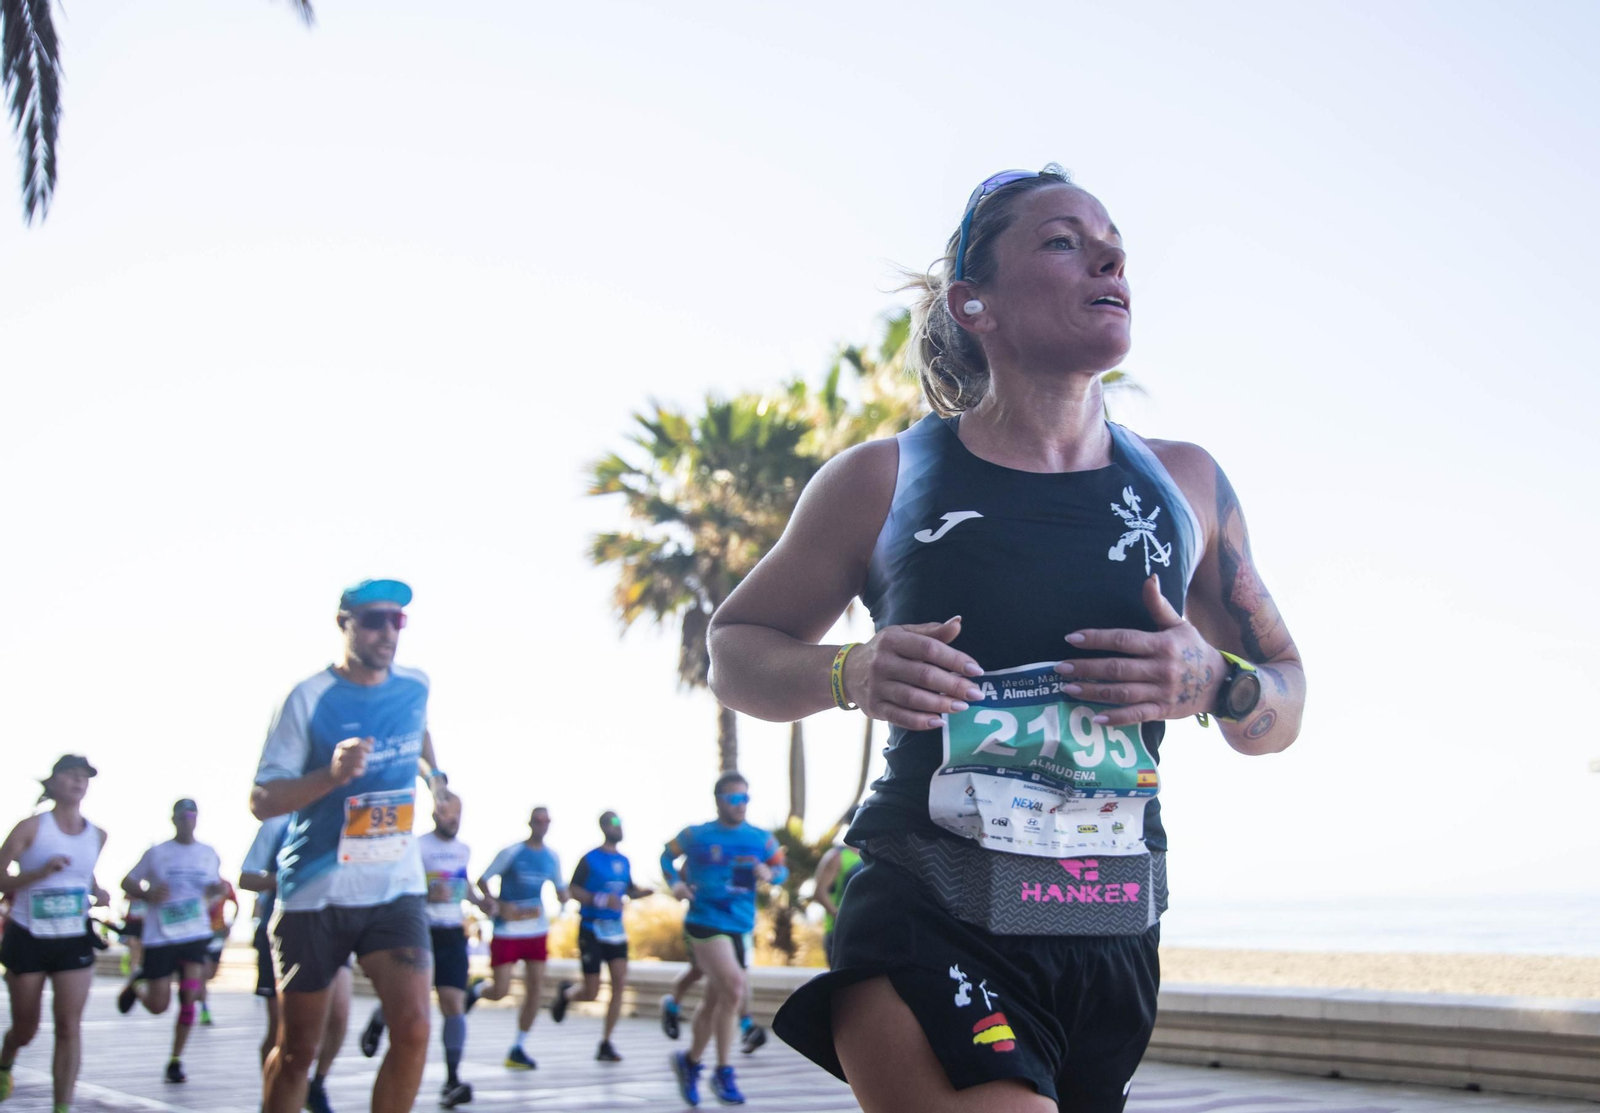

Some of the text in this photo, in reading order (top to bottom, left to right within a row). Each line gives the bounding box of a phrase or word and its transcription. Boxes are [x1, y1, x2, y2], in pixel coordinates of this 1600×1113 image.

[1001, 679, 1035, 688] Medio
[1003, 685, 1050, 700] Almería
[972, 705, 1138, 768] 2195
[1028, 758, 1096, 781] ALMUDENA
[1011, 796, 1044, 813] NEXAL
[371, 806, 397, 827] 95
[1021, 882, 1140, 903] HANKER
